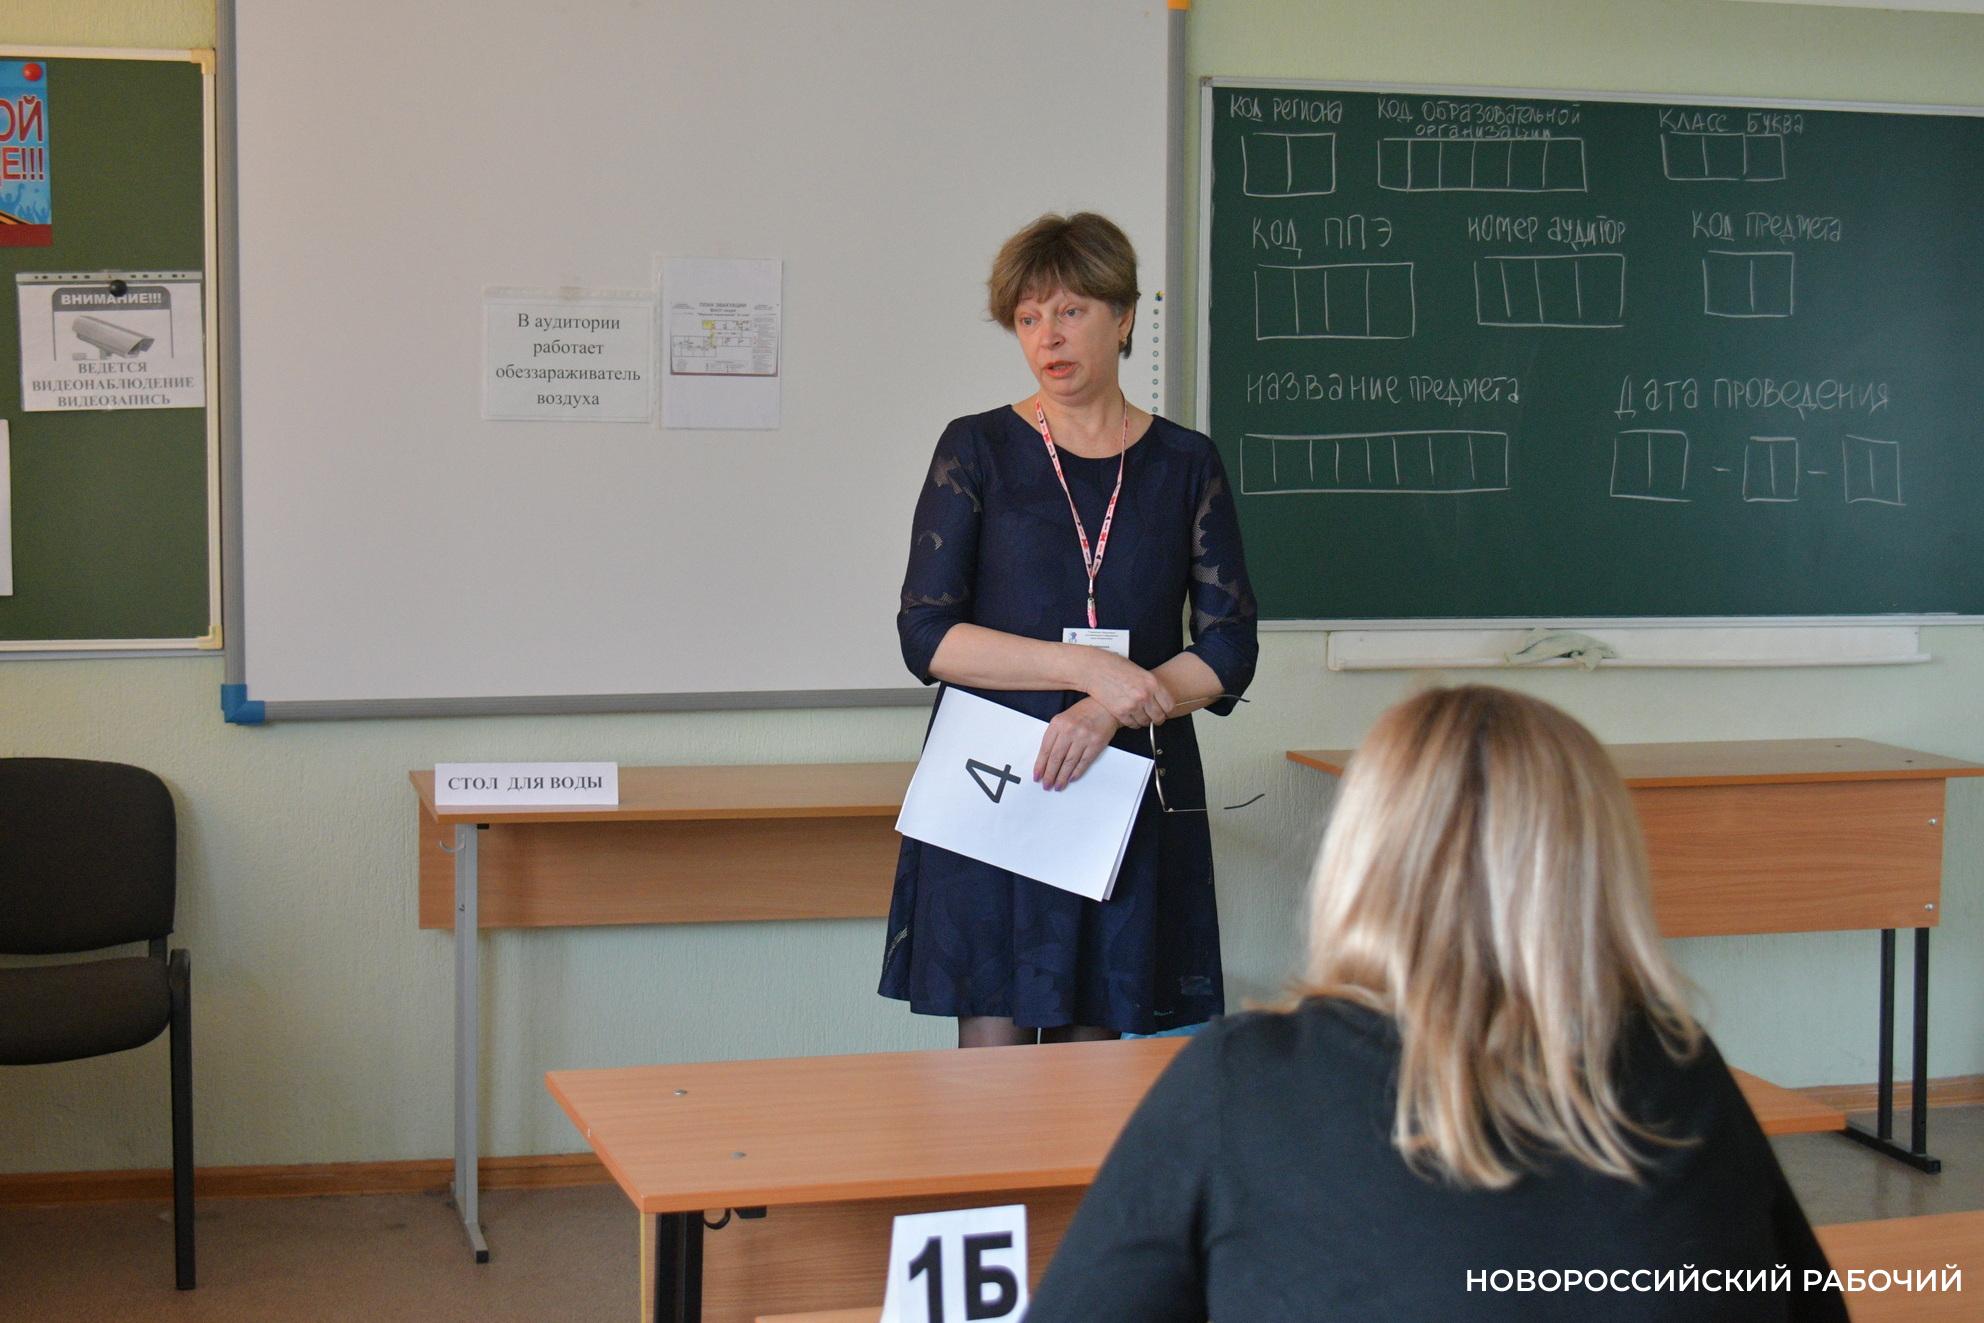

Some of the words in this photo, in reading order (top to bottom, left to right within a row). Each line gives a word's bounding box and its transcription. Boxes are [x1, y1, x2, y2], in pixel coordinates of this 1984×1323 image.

[1658, 108, 1729, 133] КЛАСС
[1324, 214, 1392, 251] ППЭ
[60, 292, 162, 305] ВНИМАНИЕ!!!
[517, 313, 530, 328] В
[534, 315, 621, 333] аудитории
[533, 339, 604, 357] работает
[78, 361, 147, 375] ВЕДЕТСЯ
[495, 364, 641, 382] обеззараживатель
[32, 377, 195, 392] ВИДЕОНАБЛЮДЕНИЕ
[58, 394, 171, 408] ВИДЕОЗАПИСЬ
[536, 392, 600, 408] воздуха
[448, 777, 498, 790] СТОЛ
[507, 777, 545, 791] ДЛЯ
[550, 776, 603, 789] ВОДЫ
[965, 758, 1021, 804] 4
[908, 1230, 1019, 1323] 1Б
